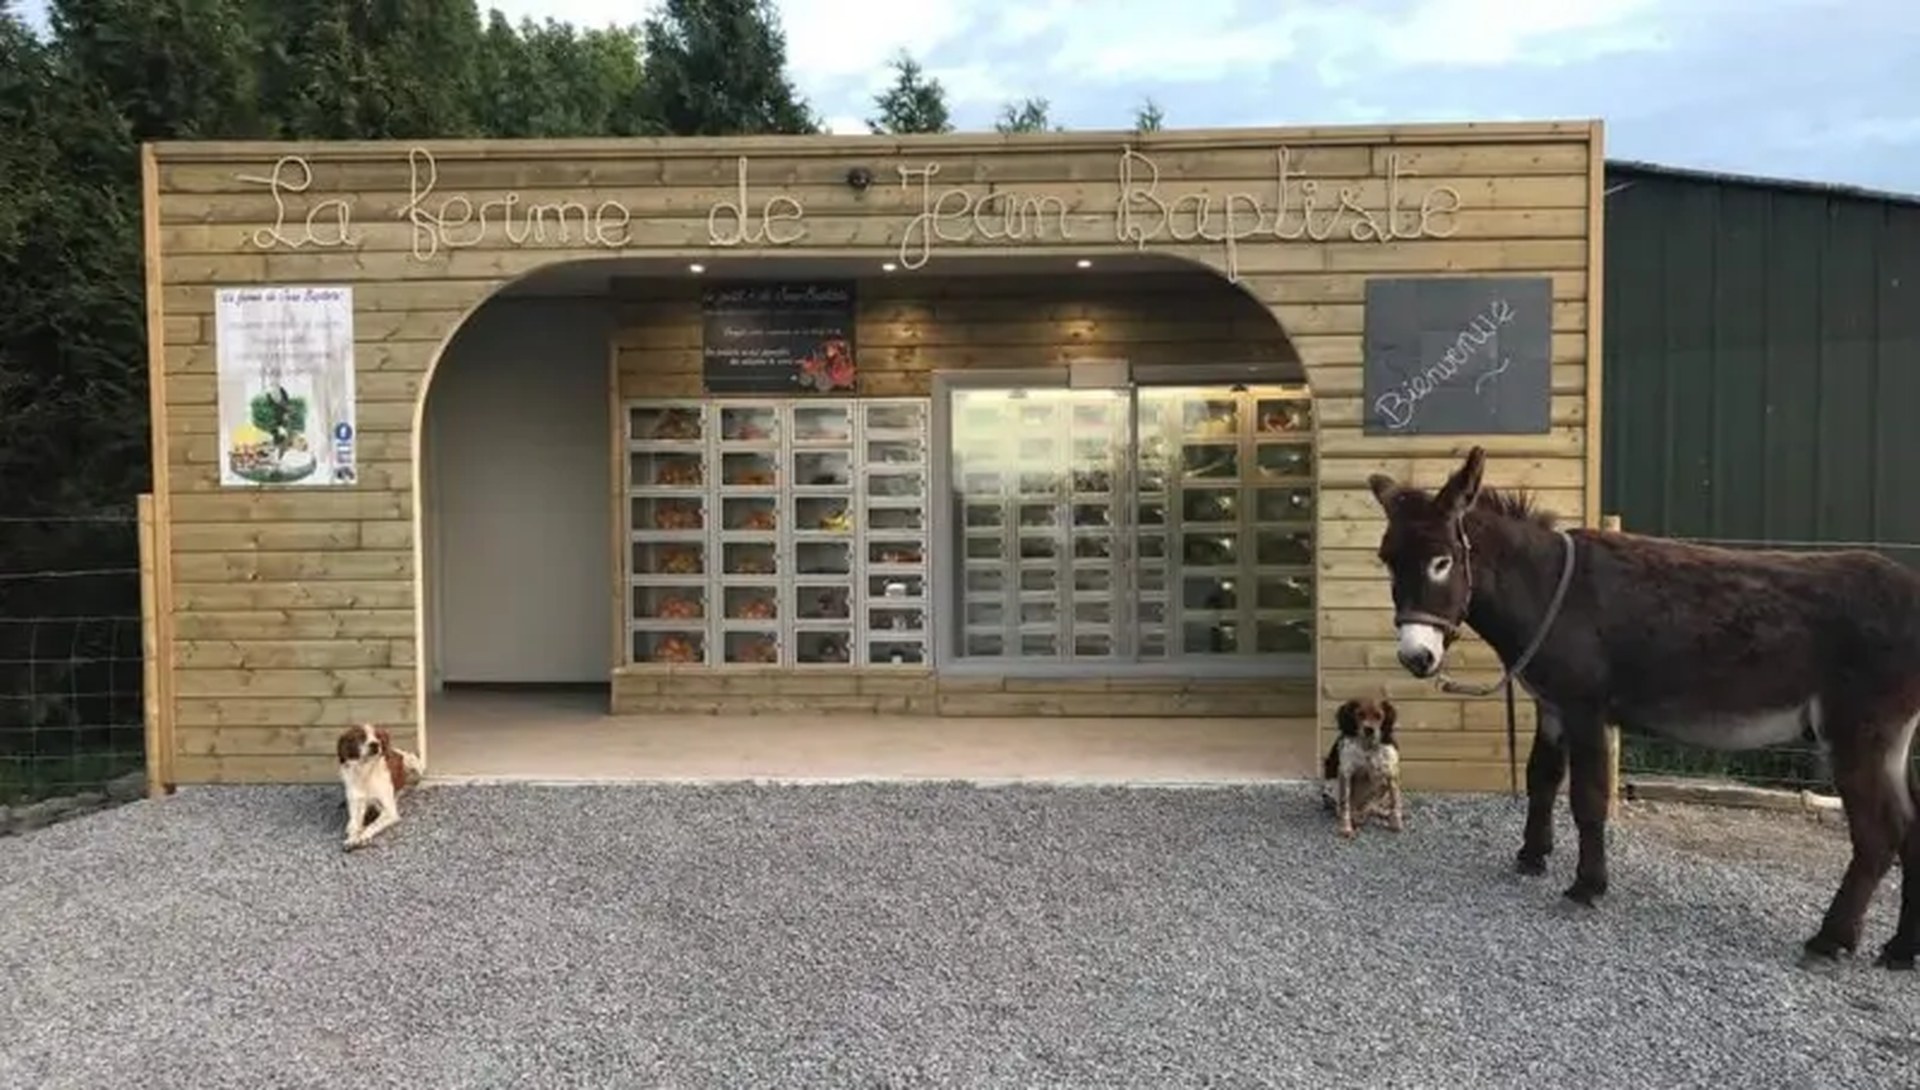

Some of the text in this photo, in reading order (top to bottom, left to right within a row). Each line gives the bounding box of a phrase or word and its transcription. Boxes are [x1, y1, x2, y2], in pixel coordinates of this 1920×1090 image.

[235, 155, 358, 249] La
[397, 147, 633, 262] ferme
[708, 156, 803, 246] de
[1374, 298, 1517, 429] Bienvenue
